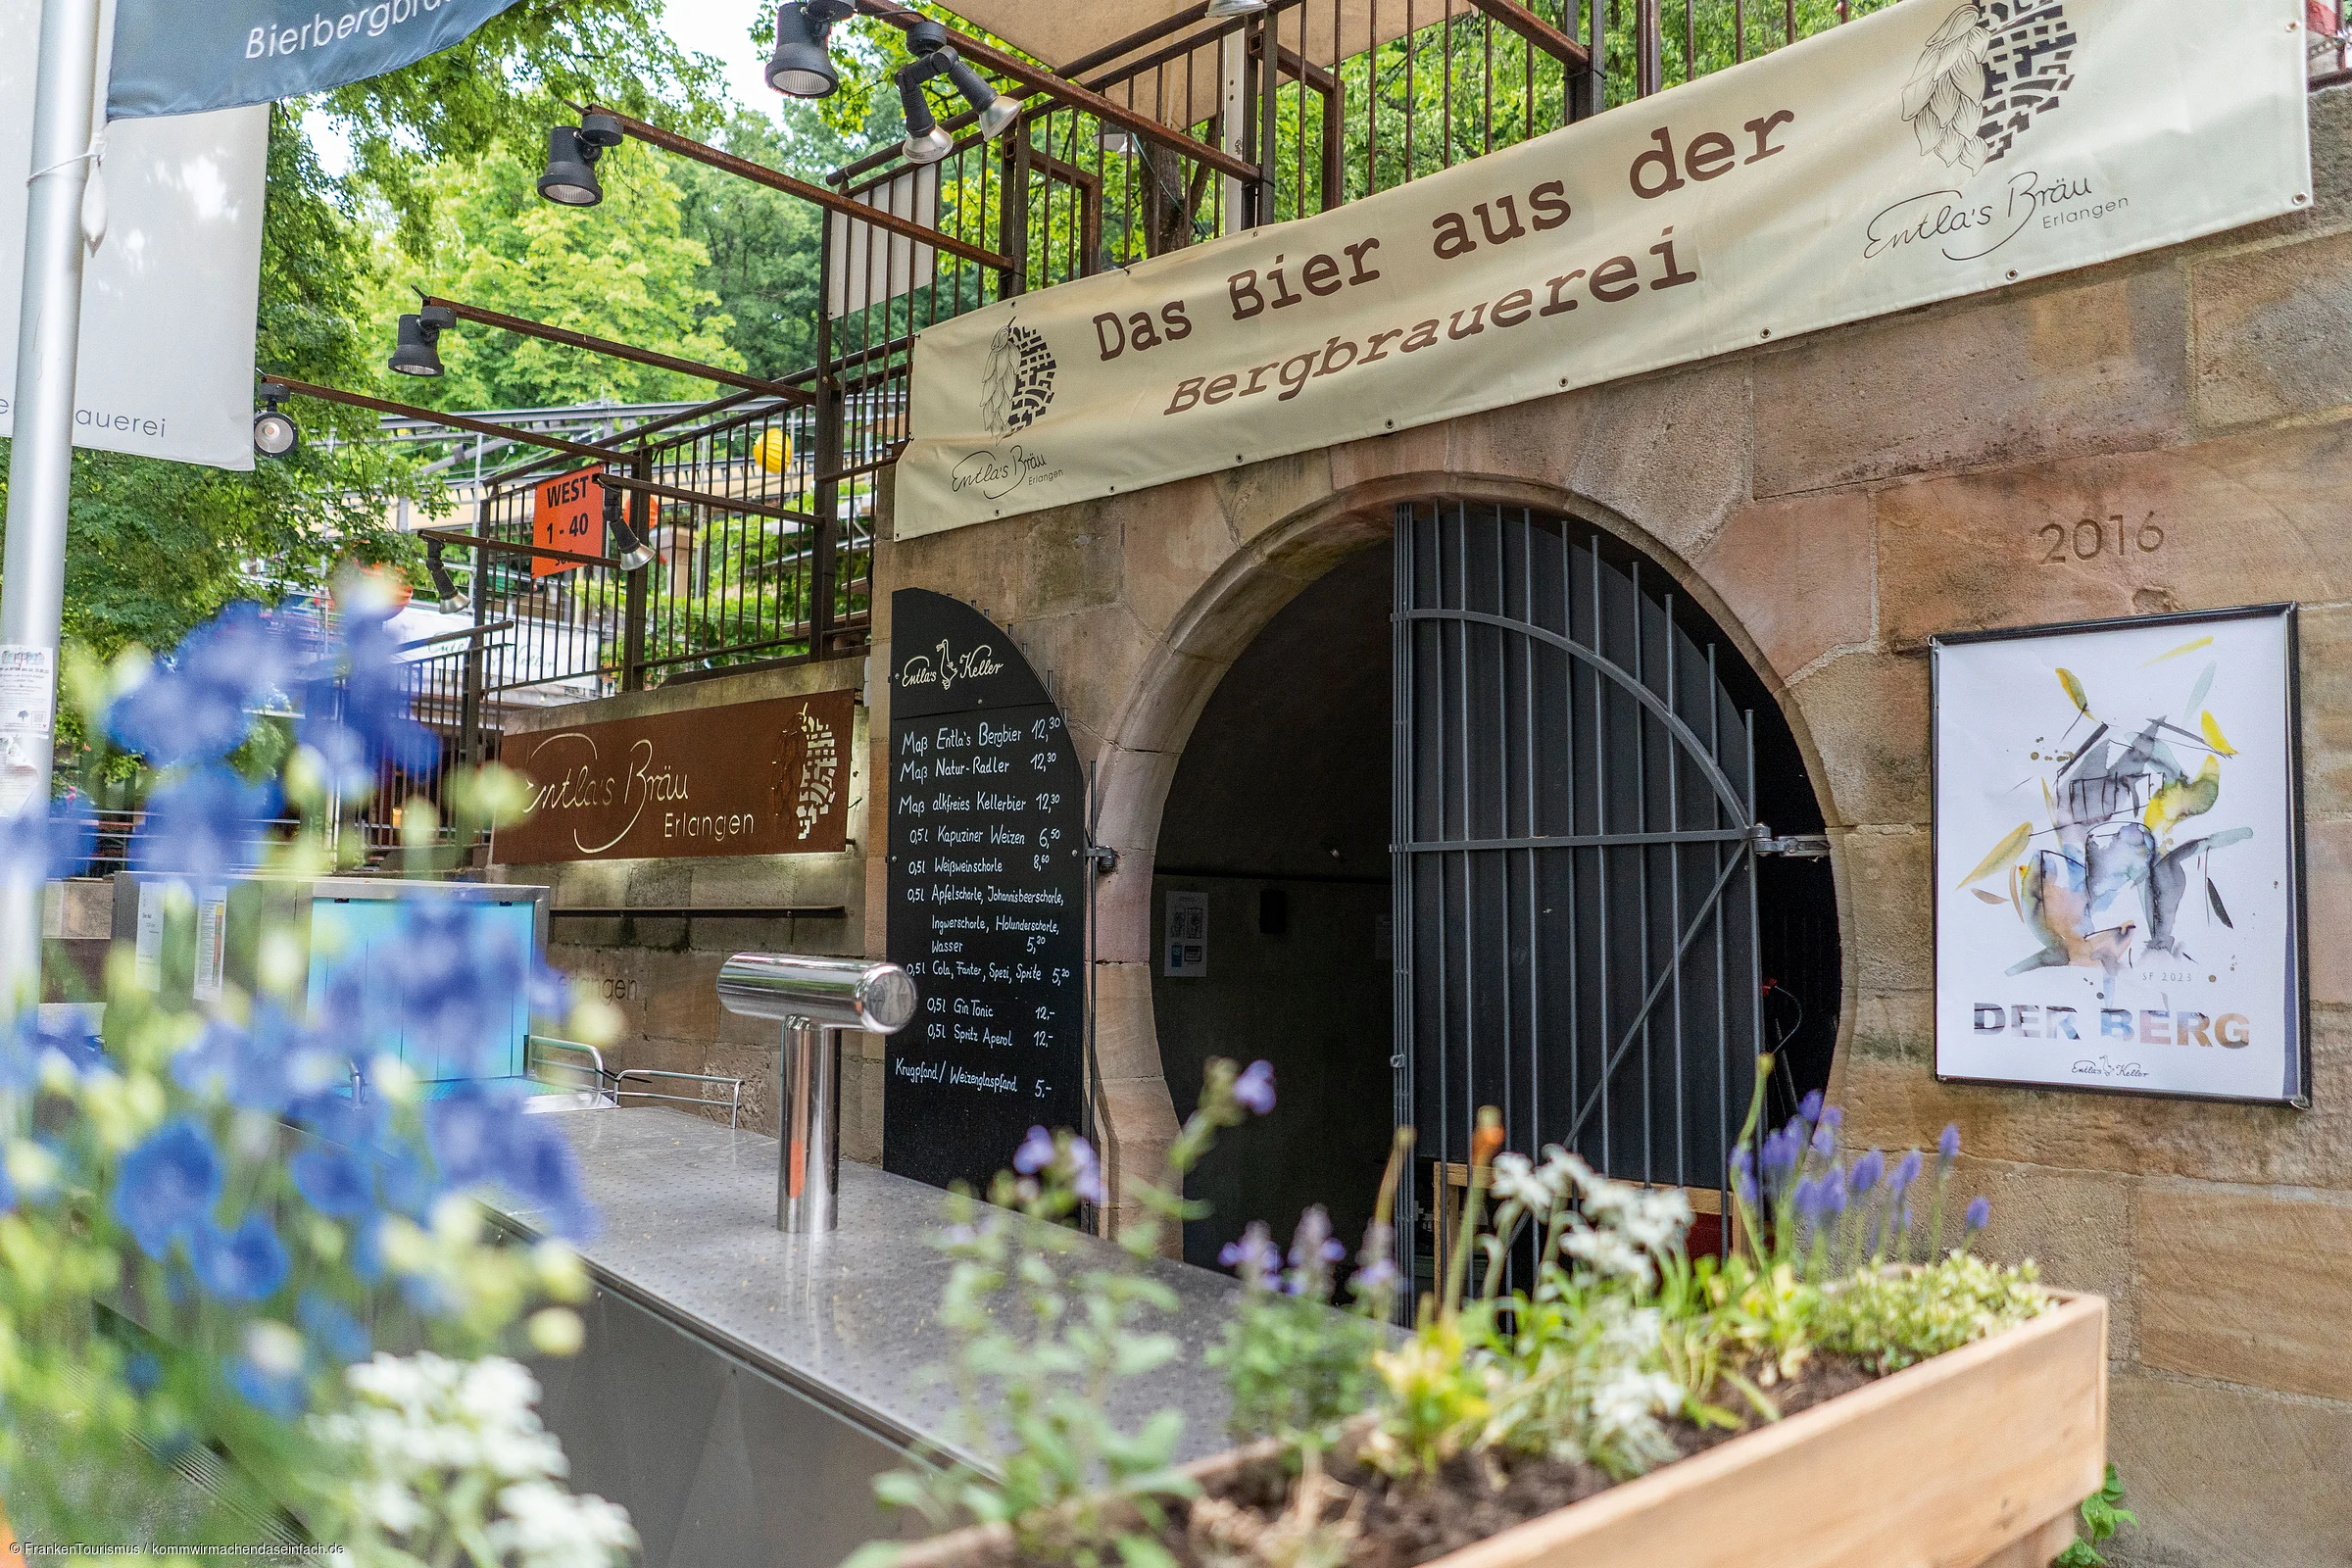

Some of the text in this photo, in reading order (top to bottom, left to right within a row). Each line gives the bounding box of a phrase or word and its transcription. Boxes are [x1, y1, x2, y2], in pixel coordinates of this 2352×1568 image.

[245, 0, 451, 59] Bierbergbra
[1863, 171, 2092, 262] Entla's Bräu
[2042, 196, 2130, 229] Erlangen
[1092, 108, 1795, 362] Das Bier aus der
[1163, 225, 1697, 416] Bergbrauerei
[75, 408, 166, 438] auerei
[983, 444, 1048, 500] Bräu
[1028, 467, 1064, 486] Erlangen
[546, 475, 589, 509] WEST
[546, 522, 554, 544] 1
[568, 513, 589, 537] 40
[2037, 510, 2164, 565] 2016
[959, 645, 1004, 679] Keller
[901, 731, 928, 757] Maß
[936, 727, 971, 750] Entla's
[978, 721, 1022, 748] Bergbier
[900, 760, 928, 785] Maß
[574, 739, 689, 854] Bräu
[898, 795, 925, 817] Maß
[932, 792, 970, 813] alkfreies
[976, 791, 1027, 813] Kellerbier
[664, 812, 755, 842] Erlangen
[937, 825, 984, 848] Kapuziner
[990, 824, 1025, 845] Weizen
[934, 857, 1004, 877] Weißweinschorle
[931, 883, 984, 906] Apfelschorle,
[987, 885, 1064, 906] Johannisbeerschorle,
[931, 914, 1059, 935] Ingwerschorle, Holunderschorle,
[931, 940, 963, 954] Wasser
[932, 959, 955, 980] Cola,
[989, 961, 1012, 984] Spezi,
[1015, 962, 1042, 984] Sprite
[2161, 972, 2192, 982] 2023
[953, 998, 969, 1015] Gin
[970, 999, 994, 1017] Tonic
[954, 1023, 979, 1044] Spritz
[982, 1027, 1013, 1049] Aperol
[1974, 1002, 2250, 1050] DER BERG
[950, 1066, 1018, 1093] Weizenglaspfand
[2115, 1062, 2150, 1077] Keller
